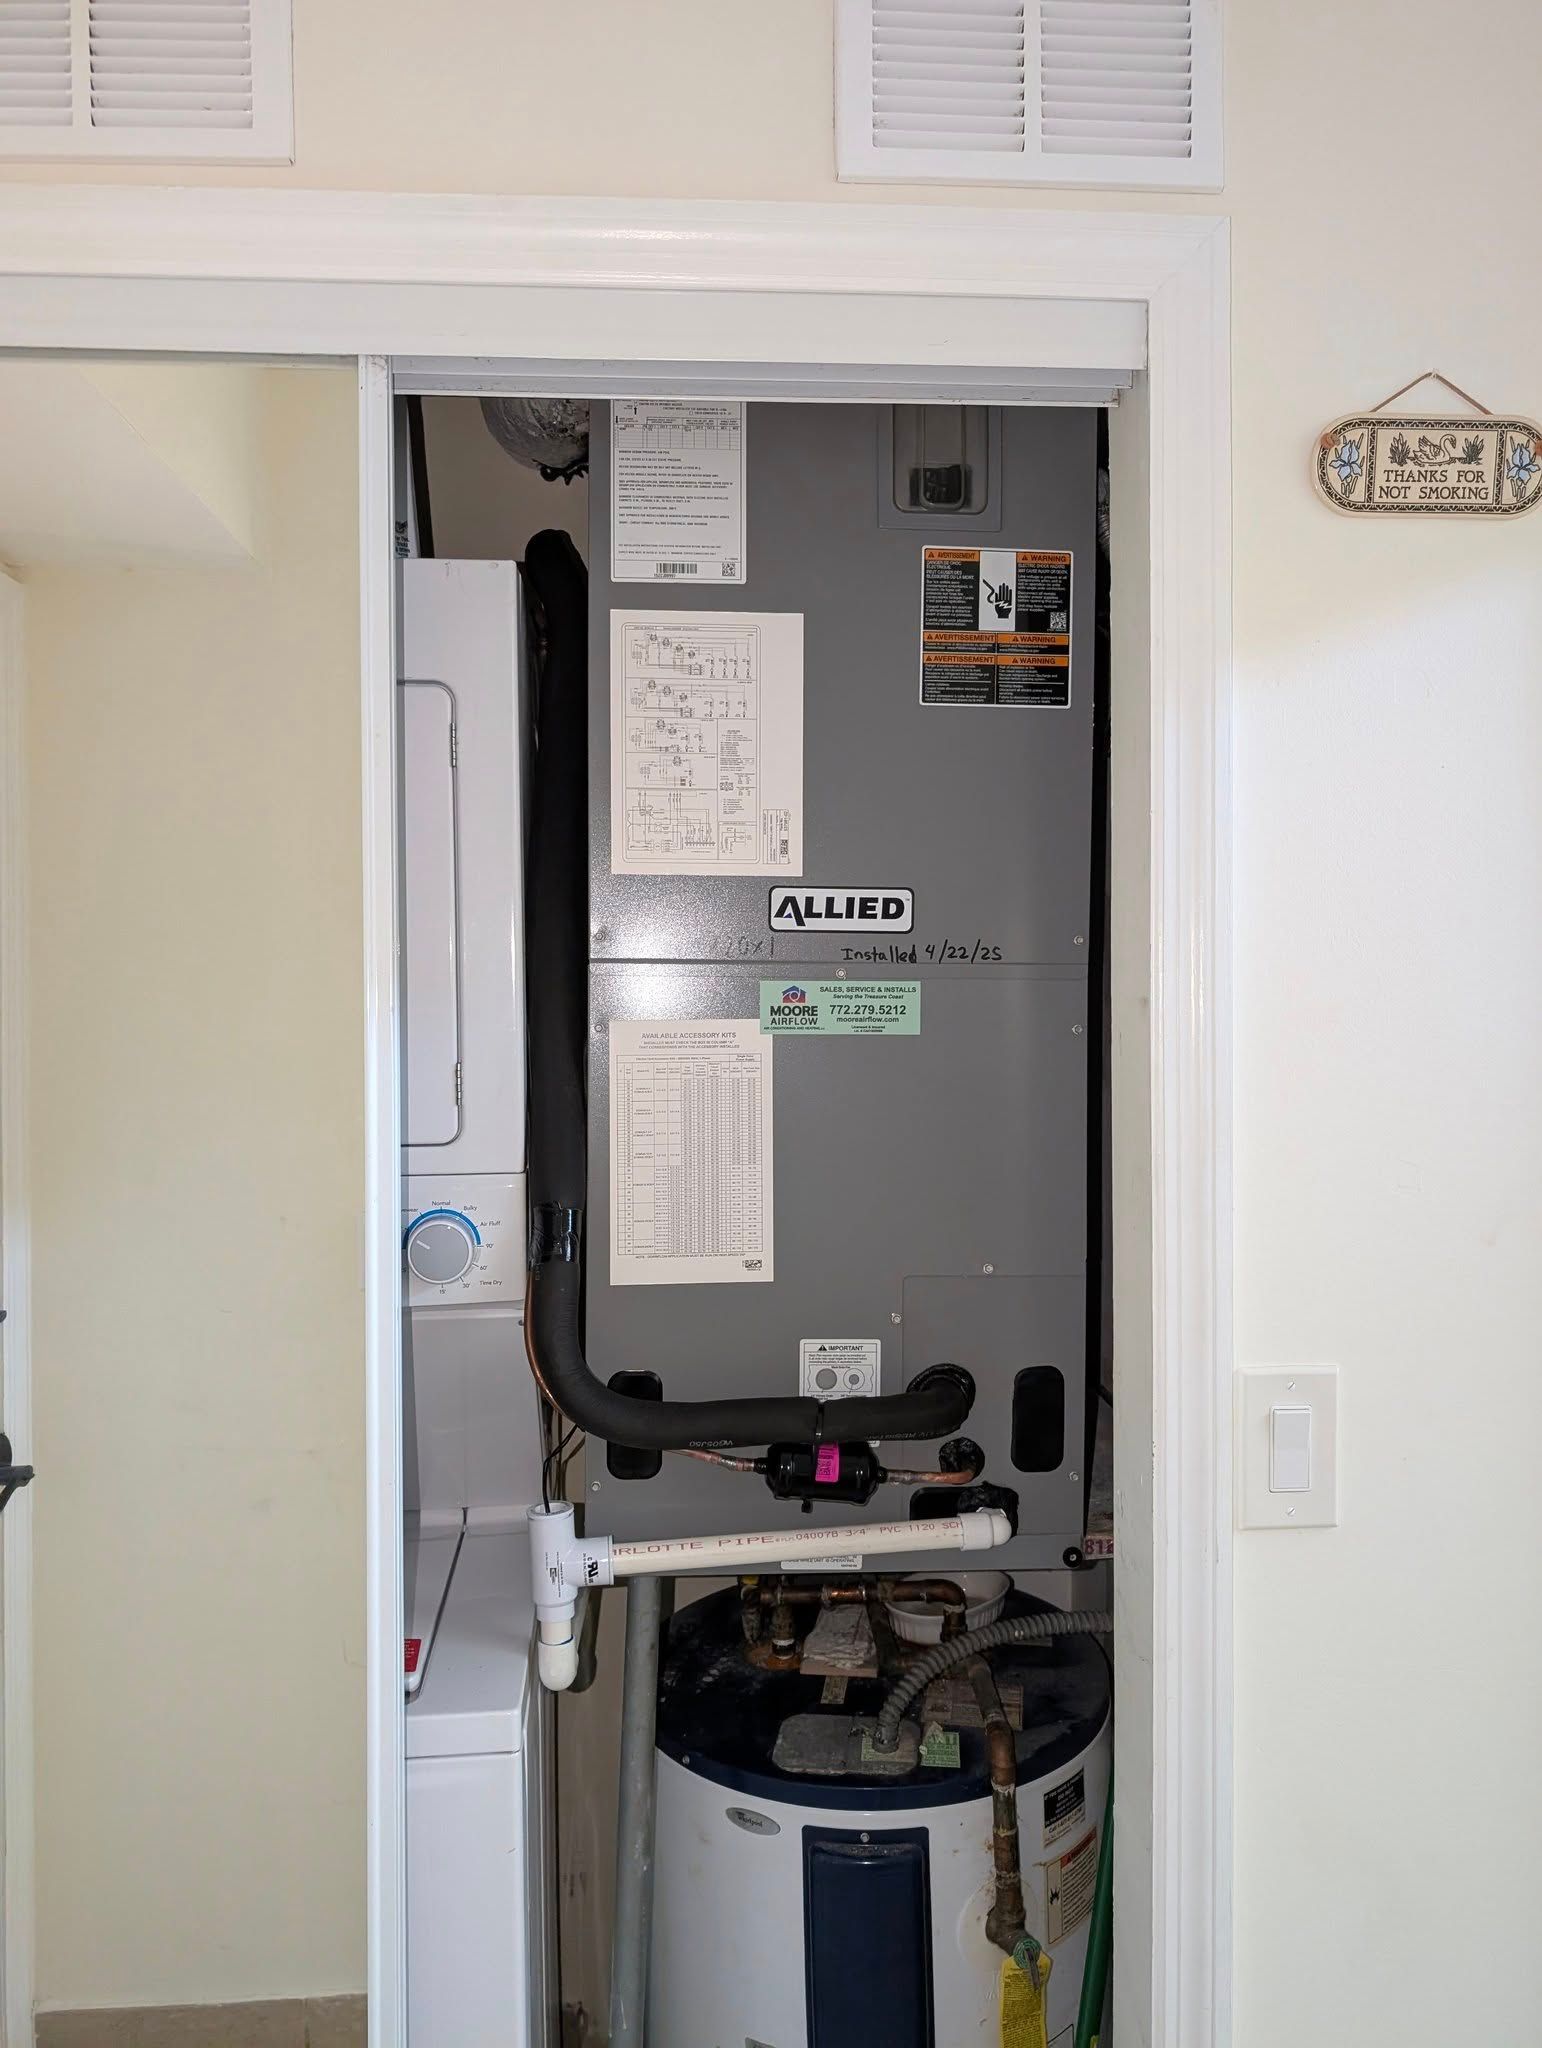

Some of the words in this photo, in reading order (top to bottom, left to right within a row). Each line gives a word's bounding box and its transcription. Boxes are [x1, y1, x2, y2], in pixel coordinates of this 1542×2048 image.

[1383, 470, 1448, 484] THANKS
[1457, 470, 1486, 484] FOR
[1378, 486, 1411, 499] NOT
[1418, 486, 1490, 500] SMOKING
[1030, 554, 1067, 562] WARNING
[934, 634, 994, 642] AVERTISSEMENT
[773, 896, 905, 926] ALLIED
[840, 944, 917, 964] Installed
[925, 938, 1002, 964] 4/22/25
[770, 1005, 818, 1017] MOORE
[829, 1005, 906, 1015] 772.279.5212
[770, 1017, 818, 1025] AIRFLOW
[718, 1535, 775, 1547] PIPE
[846, 1528, 871, 1537] 3/4"
[880, 1526, 902, 1534] PVC
[909, 1524, 935, 1532] 1120
